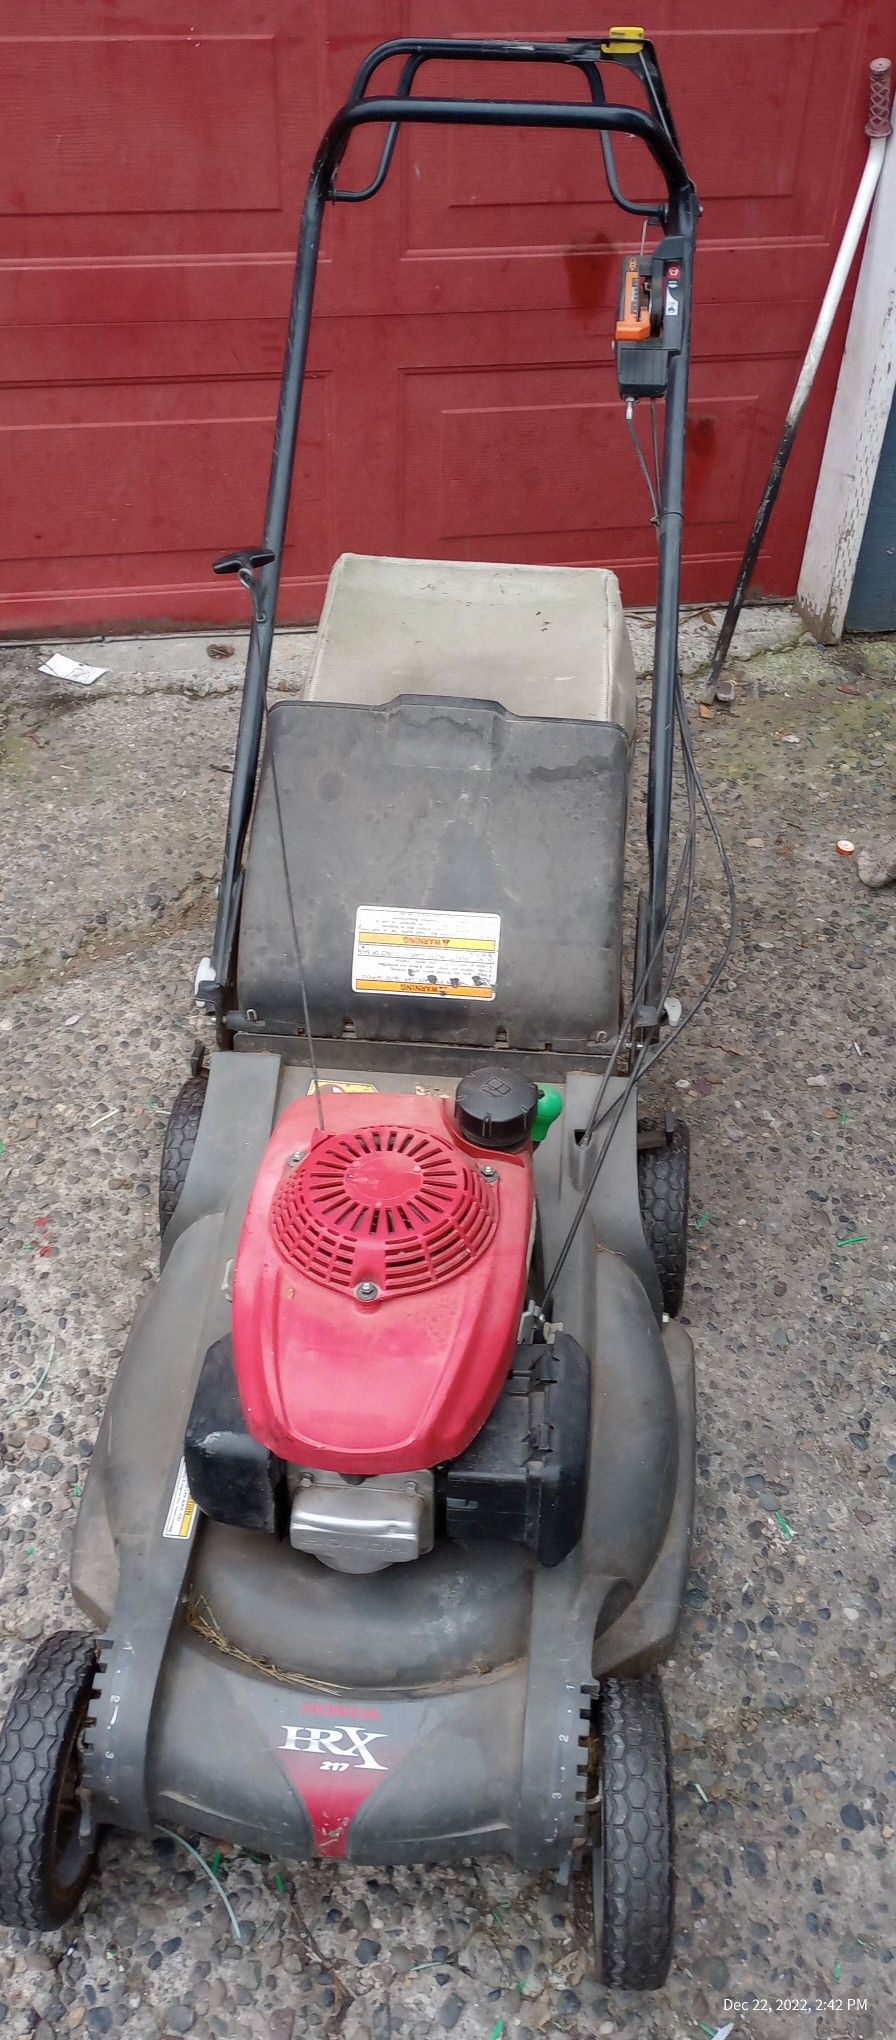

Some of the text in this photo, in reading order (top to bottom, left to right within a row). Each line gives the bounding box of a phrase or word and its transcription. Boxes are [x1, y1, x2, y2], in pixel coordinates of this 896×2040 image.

[403, 936, 441, 945] WARNING
[400, 983, 438, 992] WARNING
[558, 1733, 569, 1743] 2
[277, 1725, 389, 1770] HRX
[319, 1761, 350, 1772] 217
